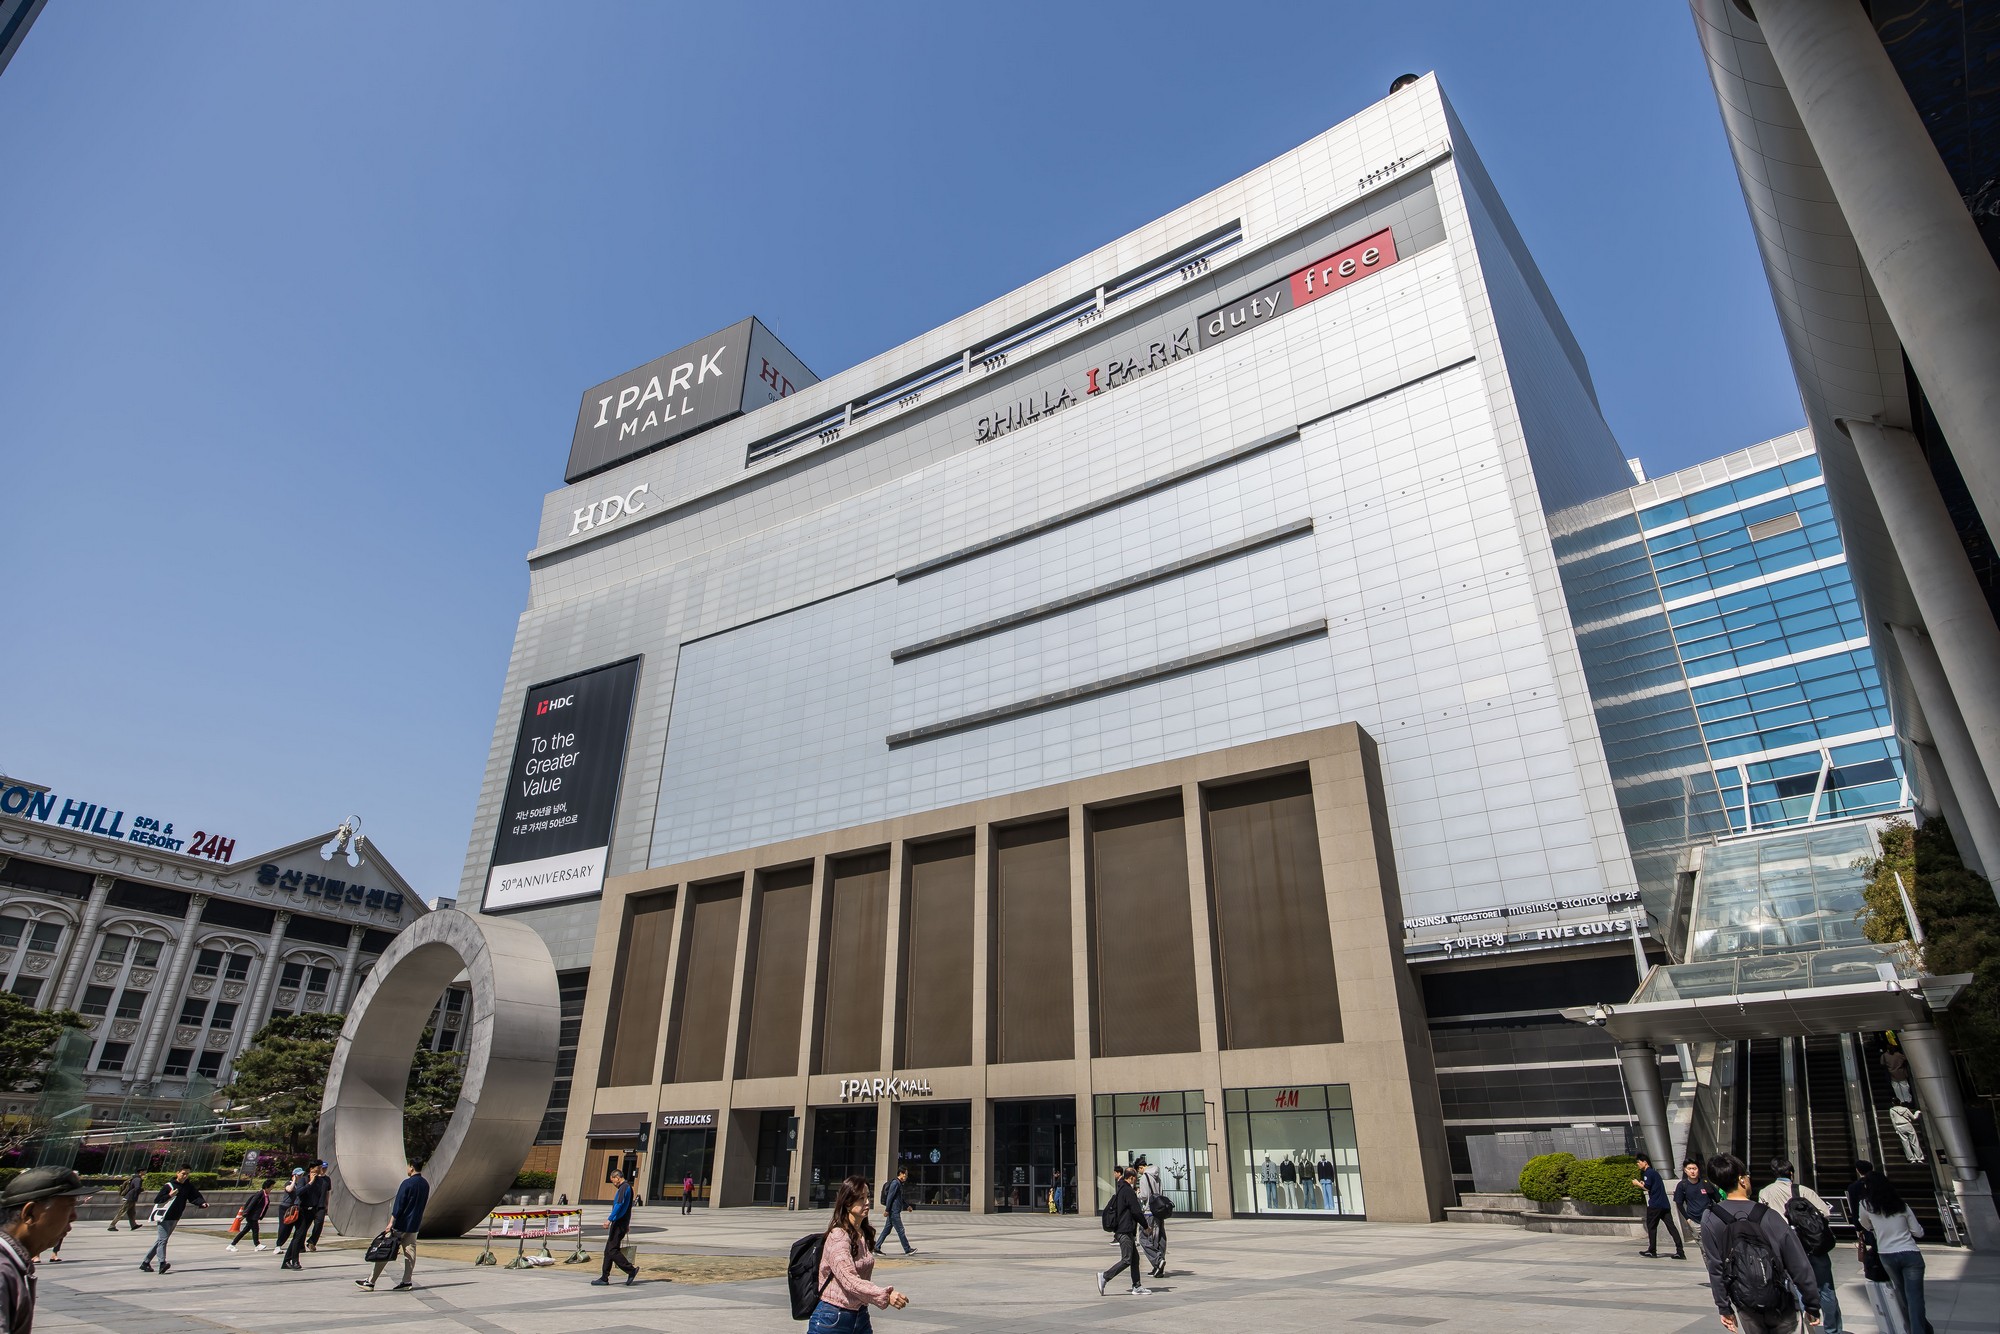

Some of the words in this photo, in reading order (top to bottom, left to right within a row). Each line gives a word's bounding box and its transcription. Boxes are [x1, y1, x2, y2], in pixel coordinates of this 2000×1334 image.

[975, 382, 1077, 442] SHILLA
[1208, 291, 1281, 337] duty
[1304, 247, 1380, 294] free
[593, 345, 727, 429] IPARK
[618, 396, 694, 442] MALL
[568, 482, 649, 537] HDC
[548, 694, 575, 711] HDC
[531, 736, 548, 754] To
[551, 732, 575, 751] the
[525, 751, 580, 776] Greater
[523, 777, 562, 798] Value
[0, 781, 58, 822] ON
[57, 798, 125, 839] HILL
[515, 810, 529, 821] 지난
[133, 815, 160, 832] SPA
[162, 822, 174, 835] &
[512, 825, 520, 835] 더
[548, 814, 579, 829] 50년으로
[128, 829, 185, 852] RESORT
[186, 830, 236, 863] 24H
[256, 863, 405, 913] 용산컨벤션센터
[1403, 915, 1449, 929] MUSINSA
[1450, 910, 1499, 923] MEGASTORE
[1508, 902, 1558, 916] musinsa
[1562, 891, 1621, 909] standard
[1624, 891, 1638, 901] 2F
[1456, 932, 1505, 950] 하나은행
[1518, 932, 1528, 941] 1F
[1537, 927, 1575, 941] FIVE
[1579, 919, 1627, 936] GUYS
[839, 1077, 899, 1098] IPARK
[900, 1078, 931, 1092] MALL
[1138, 1095, 1161, 1113] H&M
[1274, 1089, 1299, 1109] H&M
[663, 1114, 712, 1126] STARBUCKS
